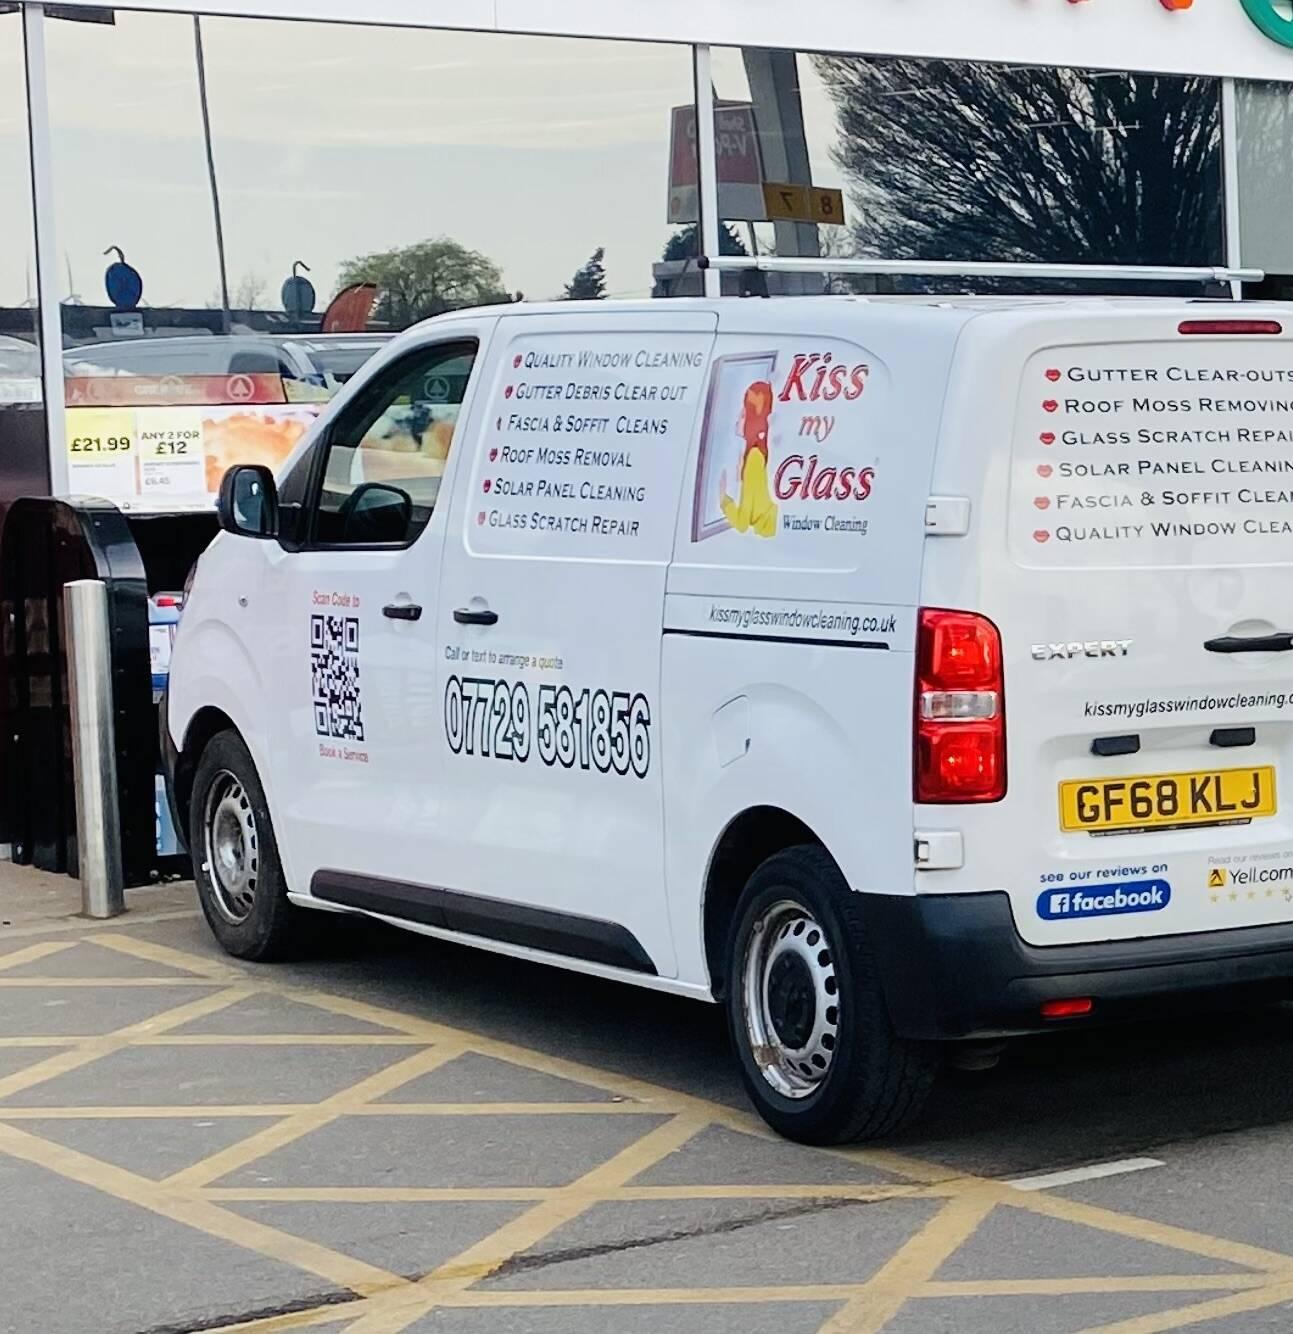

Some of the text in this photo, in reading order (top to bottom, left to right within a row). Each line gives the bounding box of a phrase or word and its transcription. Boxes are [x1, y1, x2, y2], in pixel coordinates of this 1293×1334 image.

[524, 350, 703, 369] QUALITY WINDOW CLEANING
[778, 351, 869, 402] Kiss
[1067, 367, 1158, 383] GUTTER
[516, 382, 688, 401] GUTTER DEBRIS CLEAR OUT
[1064, 399, 1125, 414] ROOF
[1132, 398, 1192, 413] MOSS
[507, 414, 669, 434] FASCIA & SOFFIT CLEANS
[798, 415, 836, 443] my
[70, 437, 131, 452] £21.99
[141, 431, 200, 440] ANY 2 FOR
[1061, 430, 1131, 446] GLASS
[1137, 429, 1230, 445] SCRATCH
[156, 441, 188, 455] £12
[501, 446, 633, 467] ROOF MOSS REMOVAL
[773, 454, 875, 501] Glass
[1059, 462, 1130, 478] SOLAR
[1138, 460, 1205, 475] PANEL
[494, 478, 645, 502] SOLAR PANEL CLEANING
[1056, 494, 1133, 510] FASCIA
[1140, 491, 1156, 507] &
[1162, 491, 1231, 506] SOFFIT
[489, 510, 640, 537] GLASS SCRATCH REPAIR
[783, 515, 868, 536] Window Cleaning
[1056, 525, 1143, 543] QUALITY
[1150, 522, 1236, 537] WINDOW
[709, 604, 897, 636] kissmyglasswindowcleaning.co.uk
[444, 645, 459, 661] Call
[460, 650, 470, 662] or
[472, 648, 487, 663] text
[488, 650, 497, 664] to
[498, 654, 530, 670] arrange
[538, 655, 564, 671] quote
[1030, 638, 1134, 661] EXPERT
[444, 674, 652, 779] 07729 581856
[1076, 771, 1261, 824] GF68 KLJ
[1039, 862, 1168, 884] see our reviews on
[1072, 886, 1164, 913] facebook
